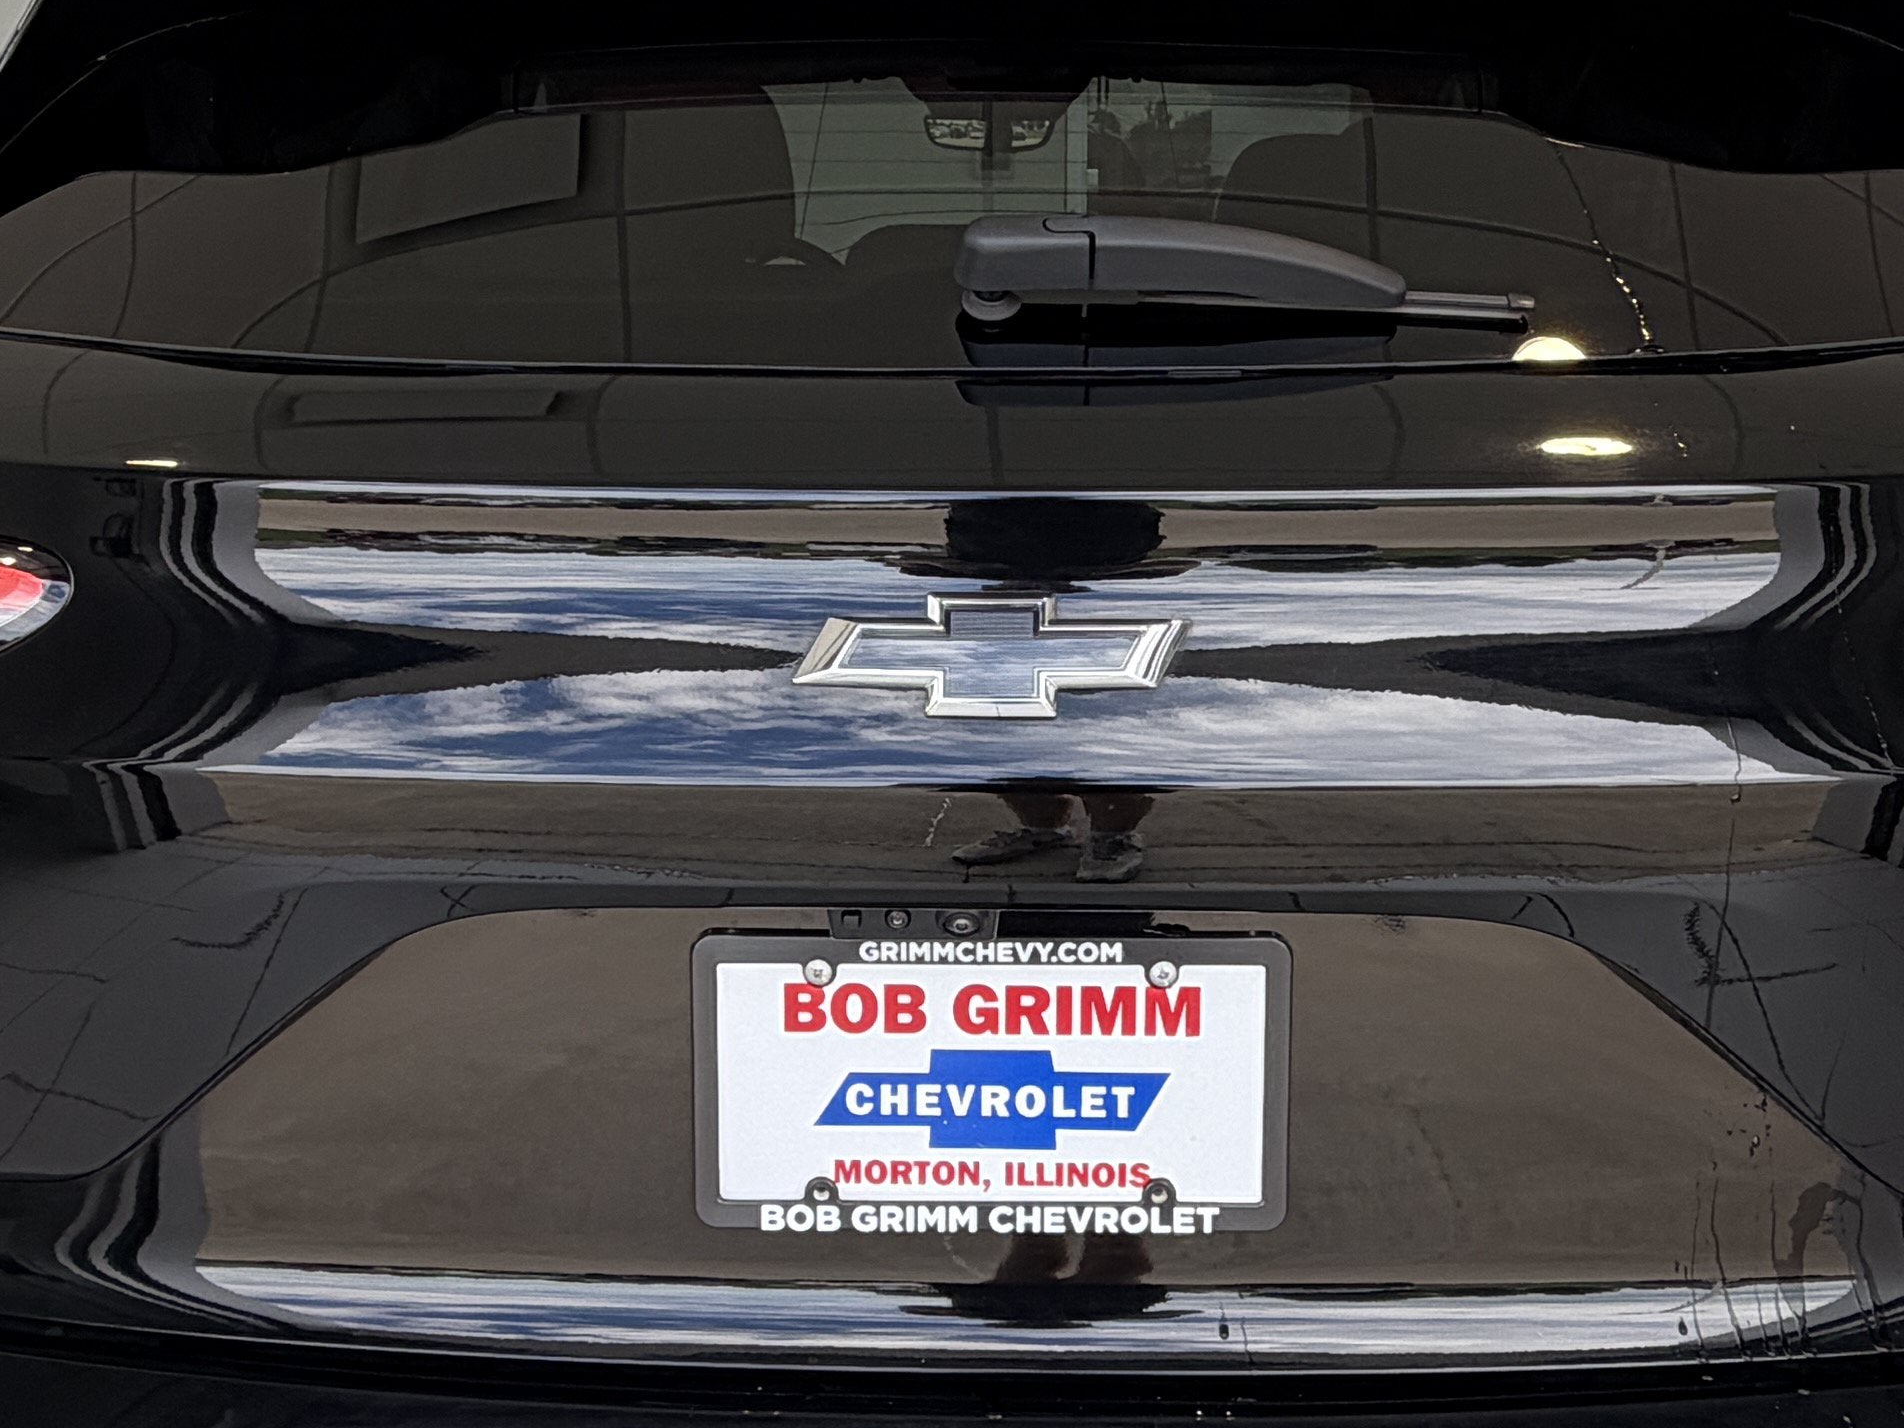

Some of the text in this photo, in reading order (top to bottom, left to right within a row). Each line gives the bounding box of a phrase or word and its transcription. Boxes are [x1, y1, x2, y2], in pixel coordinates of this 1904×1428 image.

[858, 940, 1124, 964] GRIMMCHEVY.COM
[783, 982, 1202, 1038] BOB GRIMM
[844, 1083, 1136, 1120] CHEVROLET
[833, 1159, 1152, 1193] MORTON, ILLINOIS
[759, 1203, 1221, 1235] BOB GRIMM CHEVROLET
